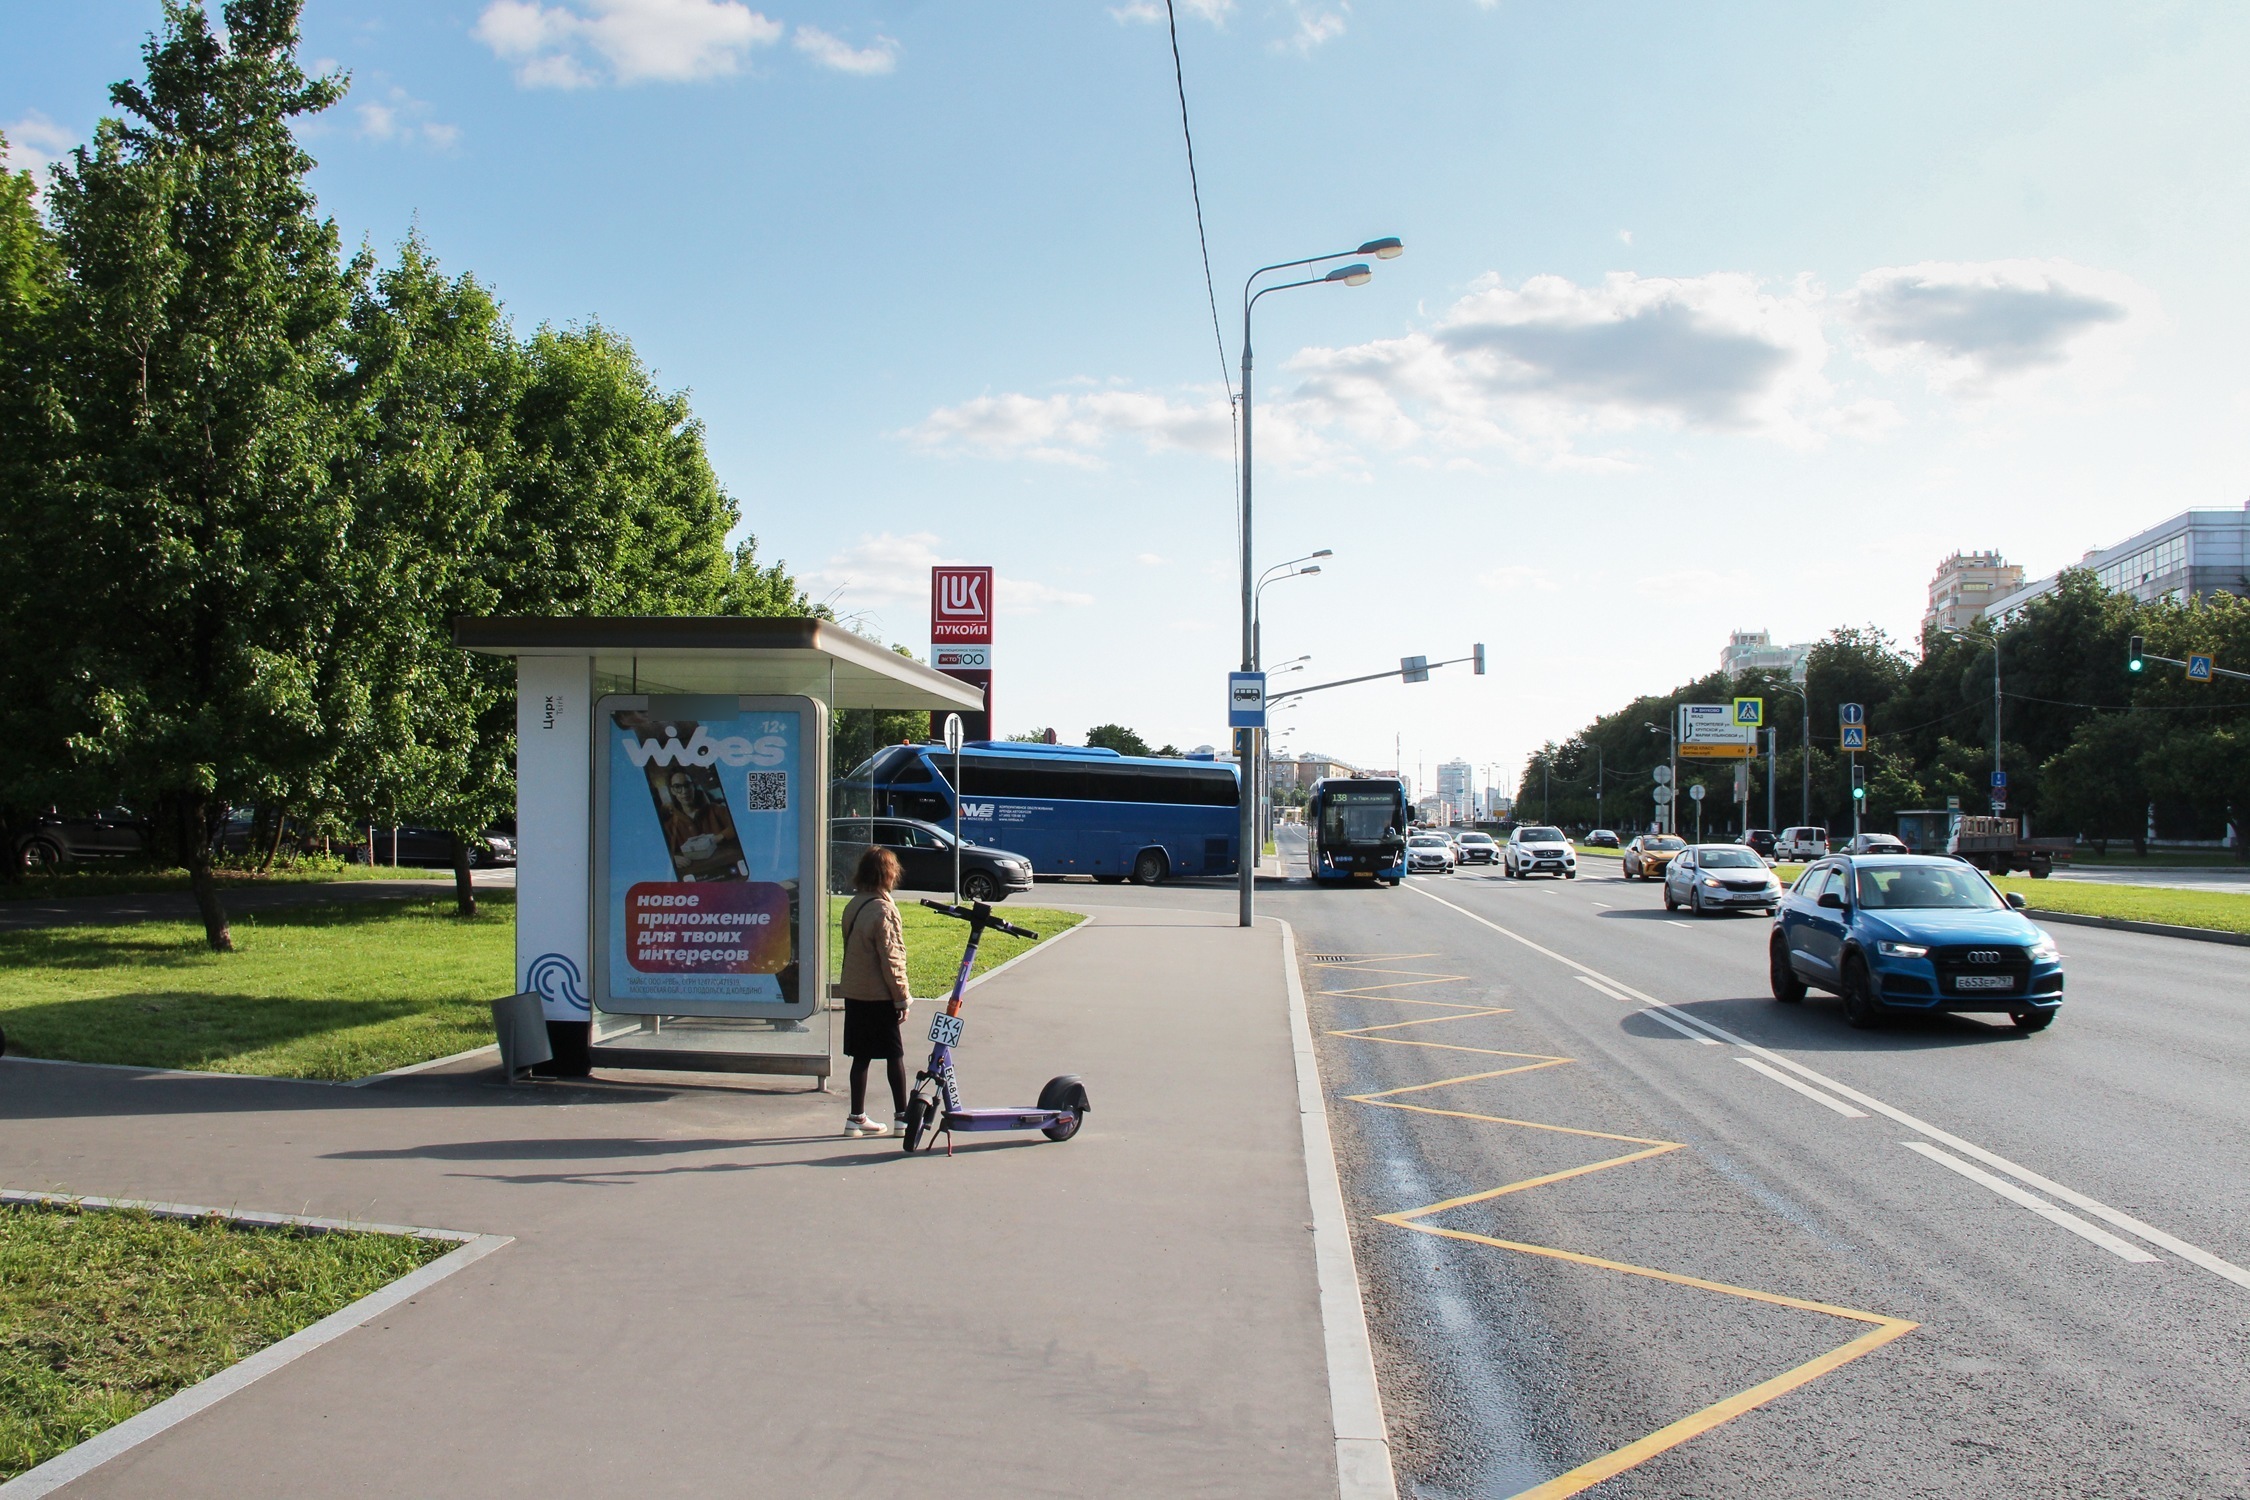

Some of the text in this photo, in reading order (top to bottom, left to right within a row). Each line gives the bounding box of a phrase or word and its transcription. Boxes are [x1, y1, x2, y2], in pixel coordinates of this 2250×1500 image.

[934, 623, 988, 635] ЛУКОЙЛ
[543, 696, 555, 729] Цирк
[761, 720, 787, 734] 12+
[1332, 793, 1348, 802] 138
[636, 894, 700, 907] новое
[637, 912, 771, 929] приложение
[637, 930, 743, 945] для твоих
[638, 948, 750, 966] интересов
[930, 1027, 959, 1046] 81X
[945, 1067, 960, 1107] EK481X
